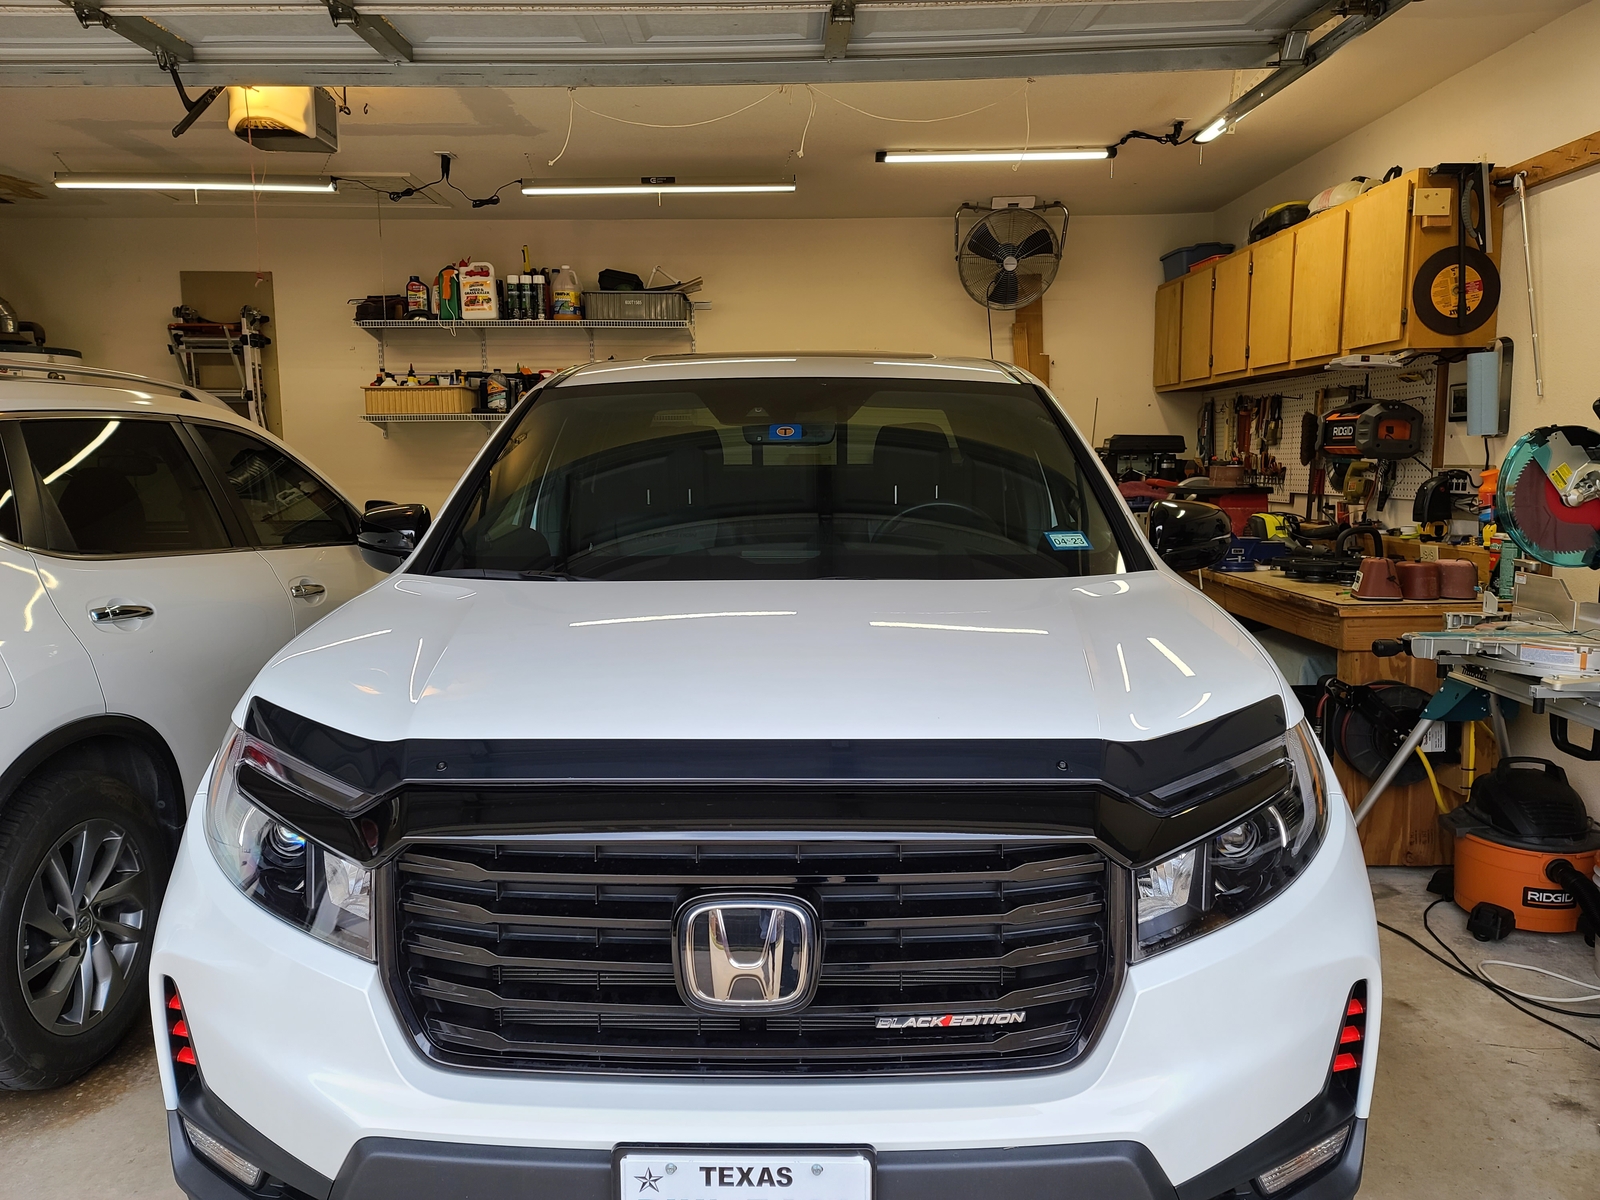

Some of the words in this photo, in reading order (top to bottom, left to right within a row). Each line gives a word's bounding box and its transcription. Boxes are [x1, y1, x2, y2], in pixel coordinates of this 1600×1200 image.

[1333, 426, 1354, 436] RIDGID
[1071, 537, 1085, 545] 23
[876, 1015, 946, 1029] BLACK
[948, 1012, 1025, 1027] EDITION
[699, 1166, 793, 1188] TEXAS
